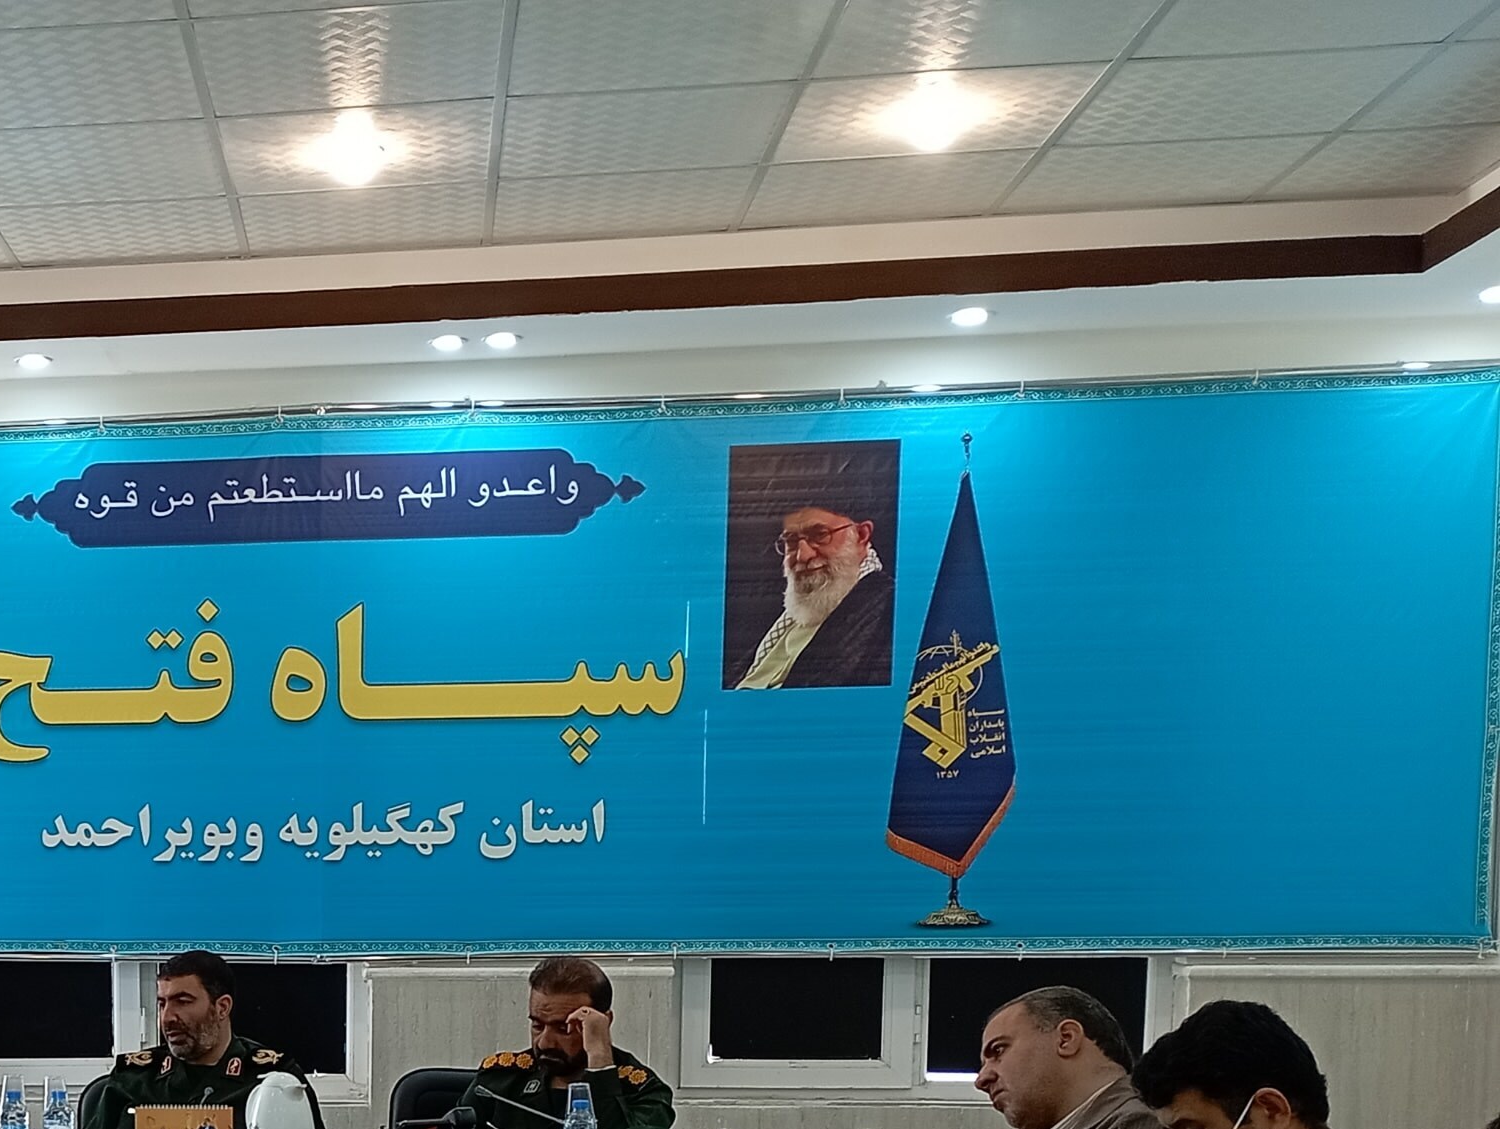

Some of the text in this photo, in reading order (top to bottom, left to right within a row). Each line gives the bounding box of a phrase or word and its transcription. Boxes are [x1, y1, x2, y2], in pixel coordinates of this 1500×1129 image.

[74, 481, 139, 519] قوه
[151, 486, 195, 517] من
[270, 602, 684, 764] سپاه
[969, 732, 1006, 744] انقلاب
[970, 745, 1006, 759] اسلامی
[278, 801, 464, 863] کهگیلویه
[480, 799, 606, 860] استان
